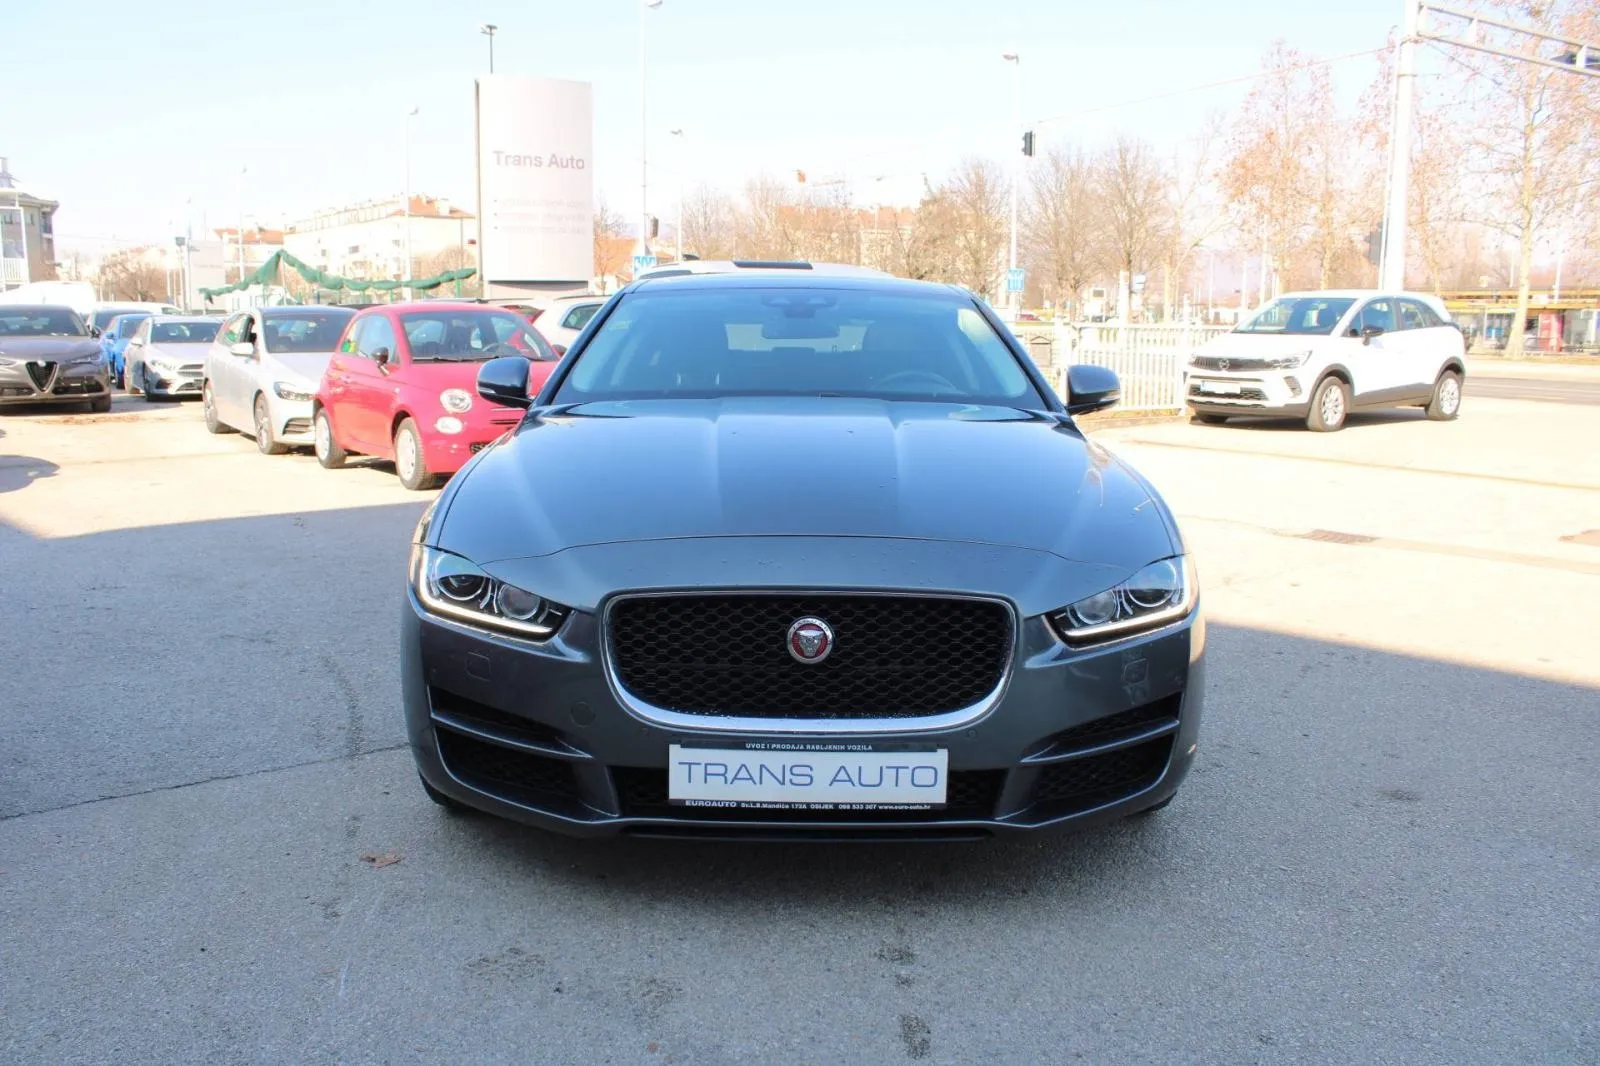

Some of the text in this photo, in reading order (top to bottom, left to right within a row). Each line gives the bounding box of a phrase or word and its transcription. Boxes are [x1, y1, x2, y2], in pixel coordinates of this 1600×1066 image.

[492, 150, 585, 170] Trans Auto
[678, 761, 938, 788] TRANS AUTO
[685, 800, 737, 808] EUROAUTO
